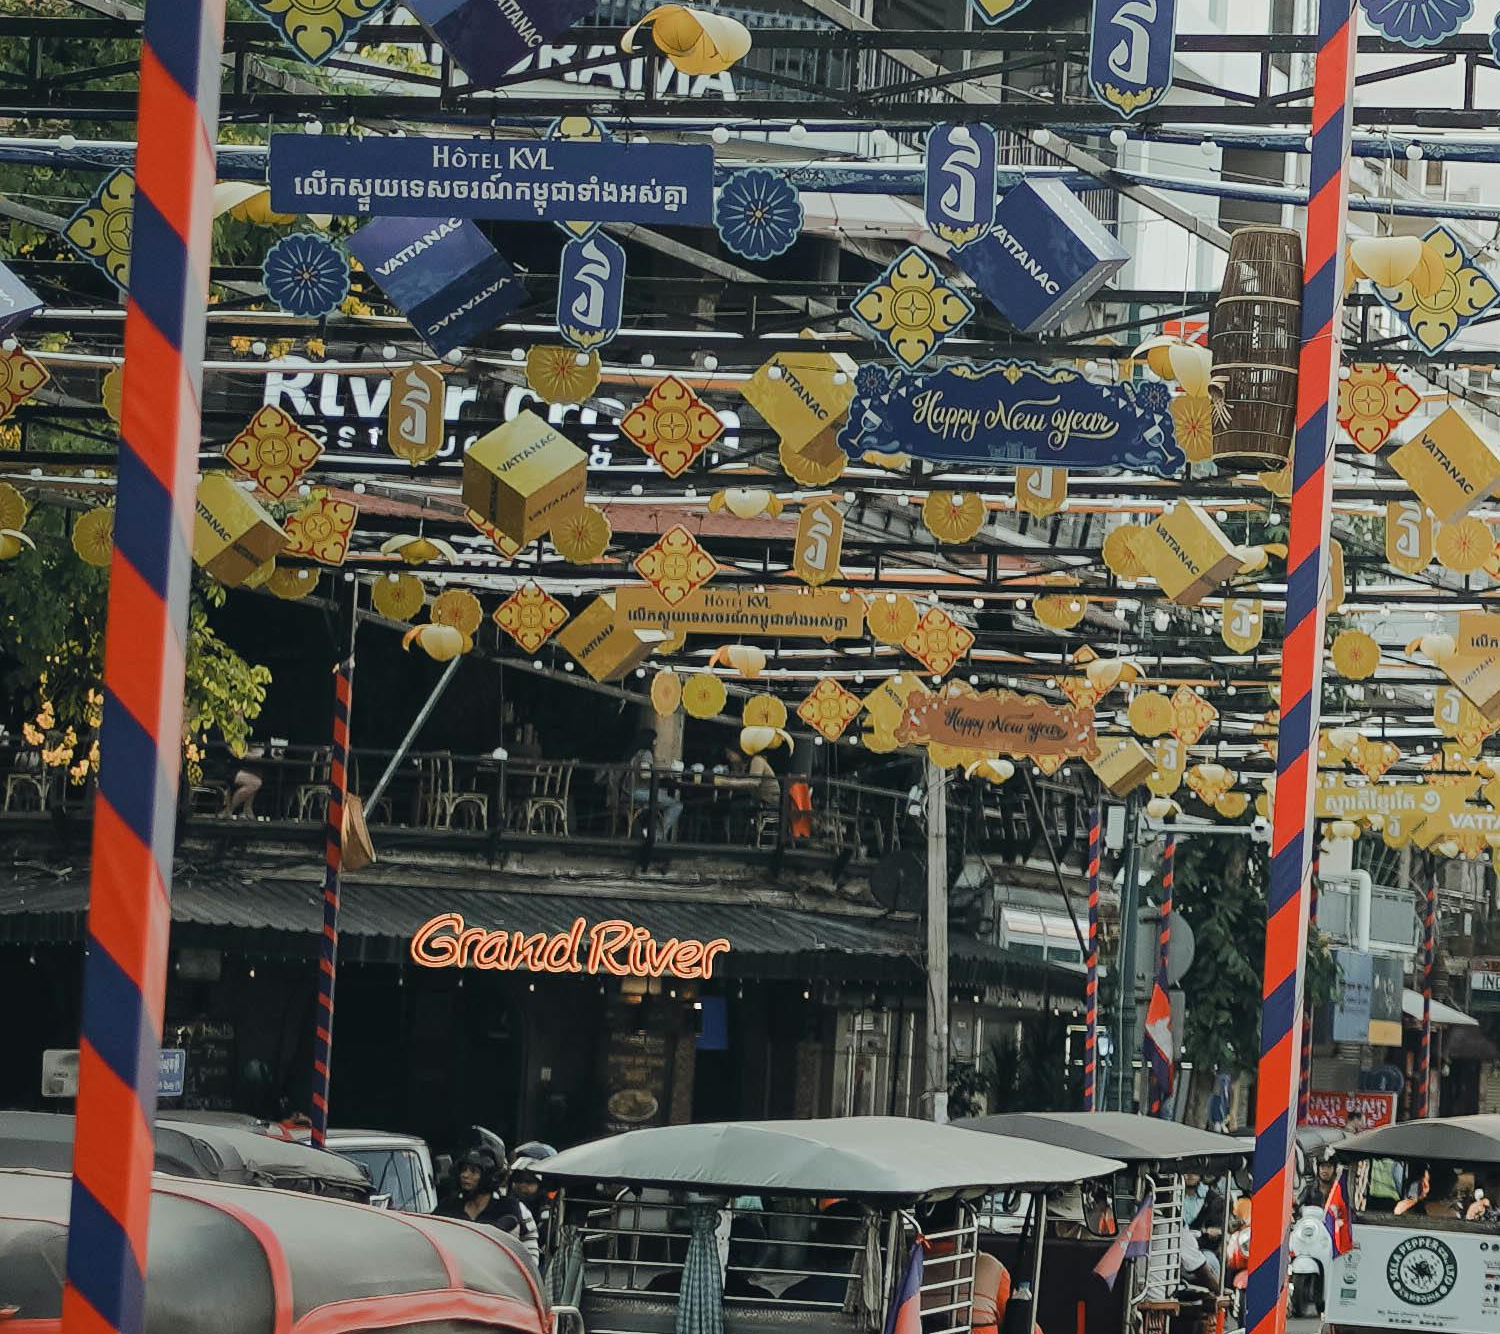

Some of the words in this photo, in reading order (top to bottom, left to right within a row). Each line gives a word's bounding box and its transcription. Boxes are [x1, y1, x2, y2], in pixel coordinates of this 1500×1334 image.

[509, 147, 555, 171] KVL
[376, 217, 464, 276] VATTANAC
[427, 276, 511, 337] VATTANAC
[263, 355, 479, 422] Rivr
[773, 358, 828, 421] VATTANAC
[912, 389, 981, 443] Happy
[984, 394, 1061, 432] New
[497, 433, 557, 474] VATTANAC
[1421, 434, 1474, 496] VATTANAC
[193, 499, 233, 543] ATTANAC
[528, 482, 583, 524] VATTANAC
[1156, 523, 1200, 575] VATTANAC
[577, 624, 616, 659] VATTANA
[1461, 656, 1497, 688] VATTAN
[410, 912, 587, 973] Grand
[588, 918, 732, 981] River
[1306, 1113, 1376, 1129] MASSE
[1398, 1237, 1439, 1255] PEPPER
